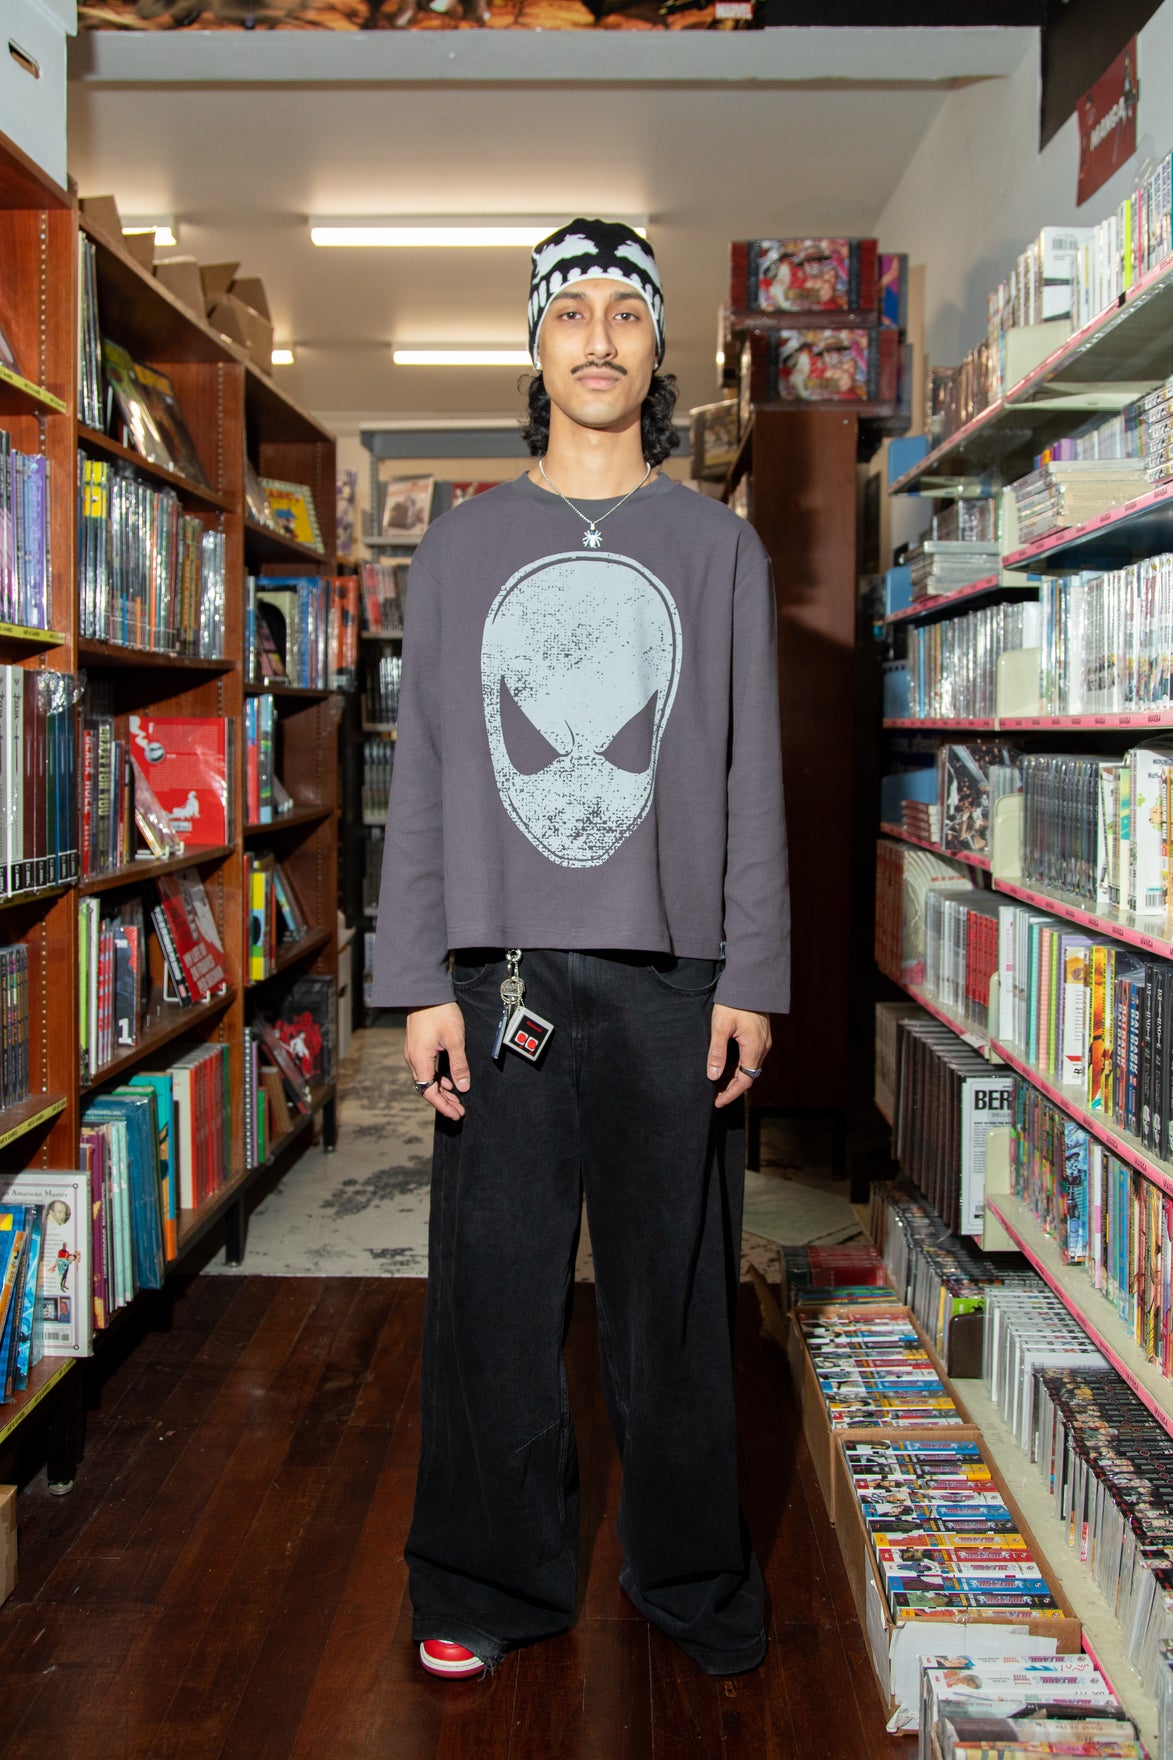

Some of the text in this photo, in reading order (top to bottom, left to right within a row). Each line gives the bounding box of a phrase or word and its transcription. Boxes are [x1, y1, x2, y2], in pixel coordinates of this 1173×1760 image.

[84, 735, 94, 813] BLACK HOLE
[98, 793, 111, 816] YOU
[118, 1018, 134, 1045] 1
[974, 1089, 1012, 1111] BER
[1028, 1655, 1065, 1663] BLEACH
[1040, 1676, 1077, 1684] BLEACH
